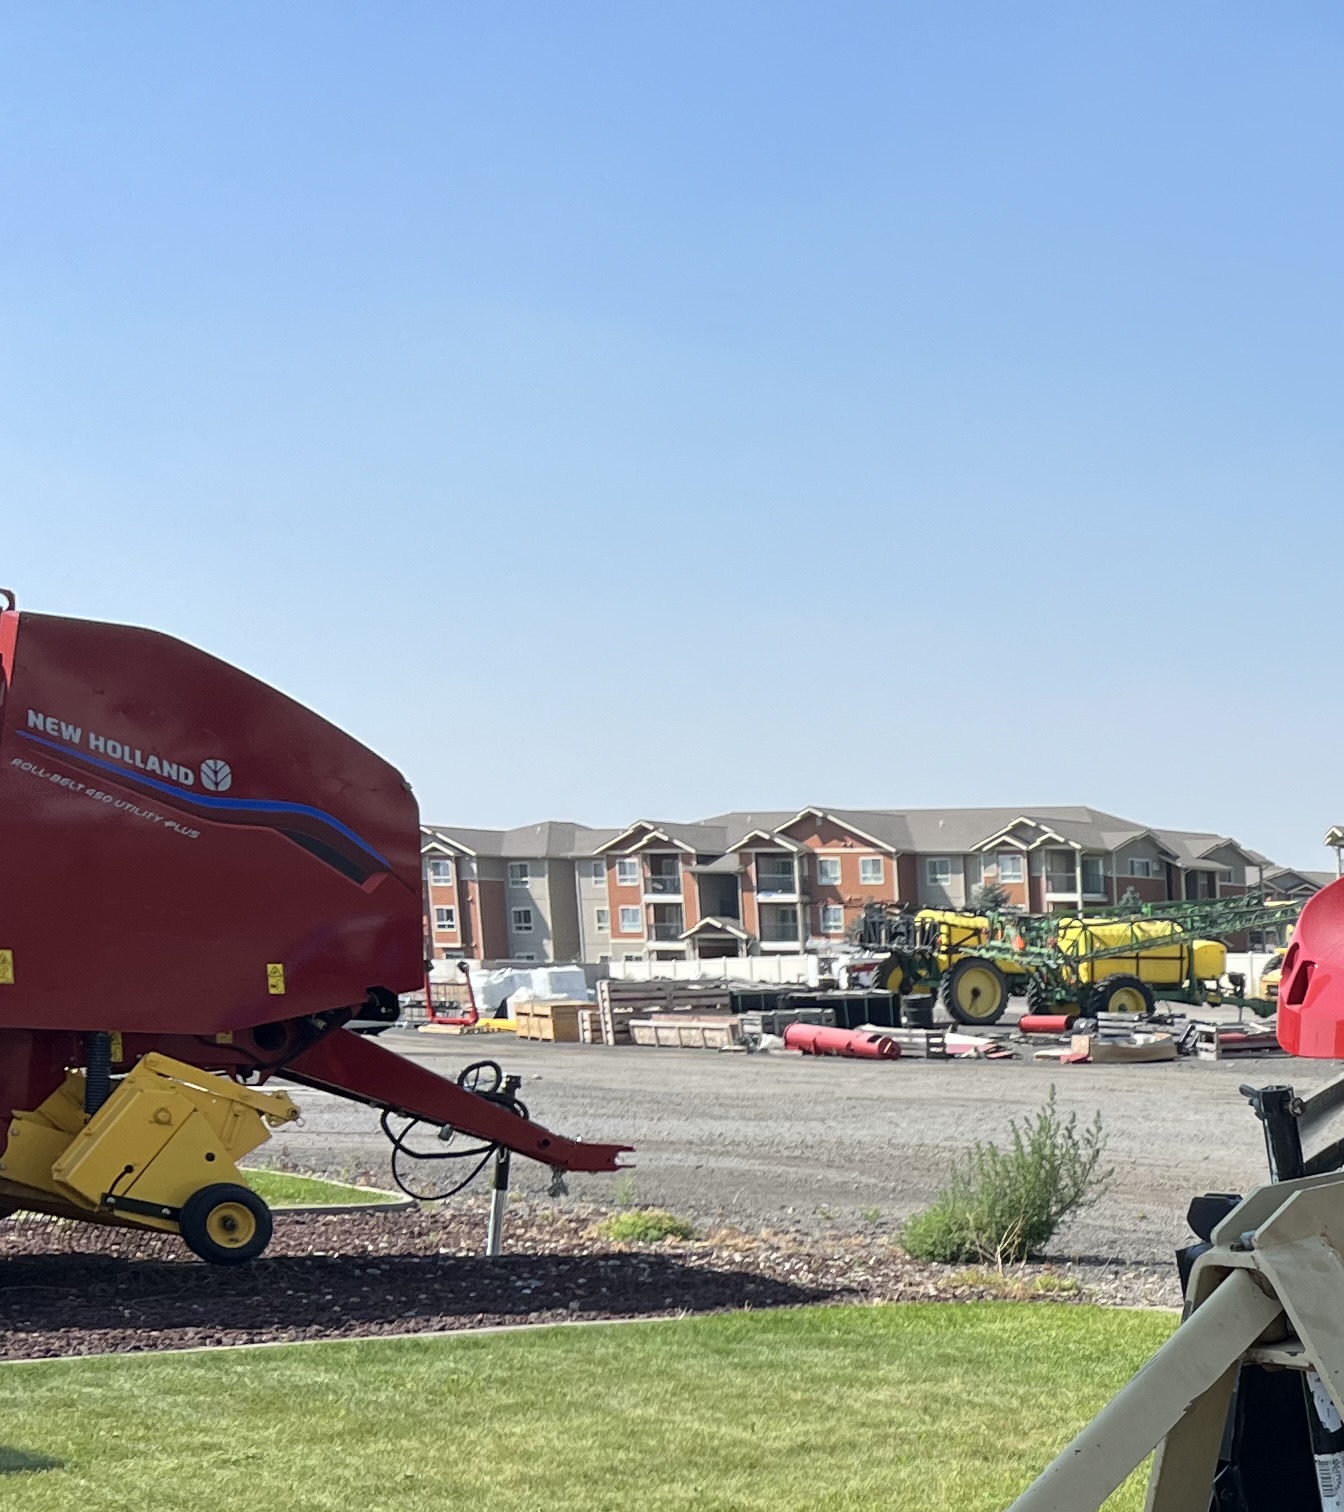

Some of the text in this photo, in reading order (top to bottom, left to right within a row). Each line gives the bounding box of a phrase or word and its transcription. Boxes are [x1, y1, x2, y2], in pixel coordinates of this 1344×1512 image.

[27, 709, 195, 787] NEW HOLLAND
[11, 758, 86, 793] ROLL-BELT
[114, 799, 164, 824] UTILITY
[163, 820, 201, 839] PLUS
